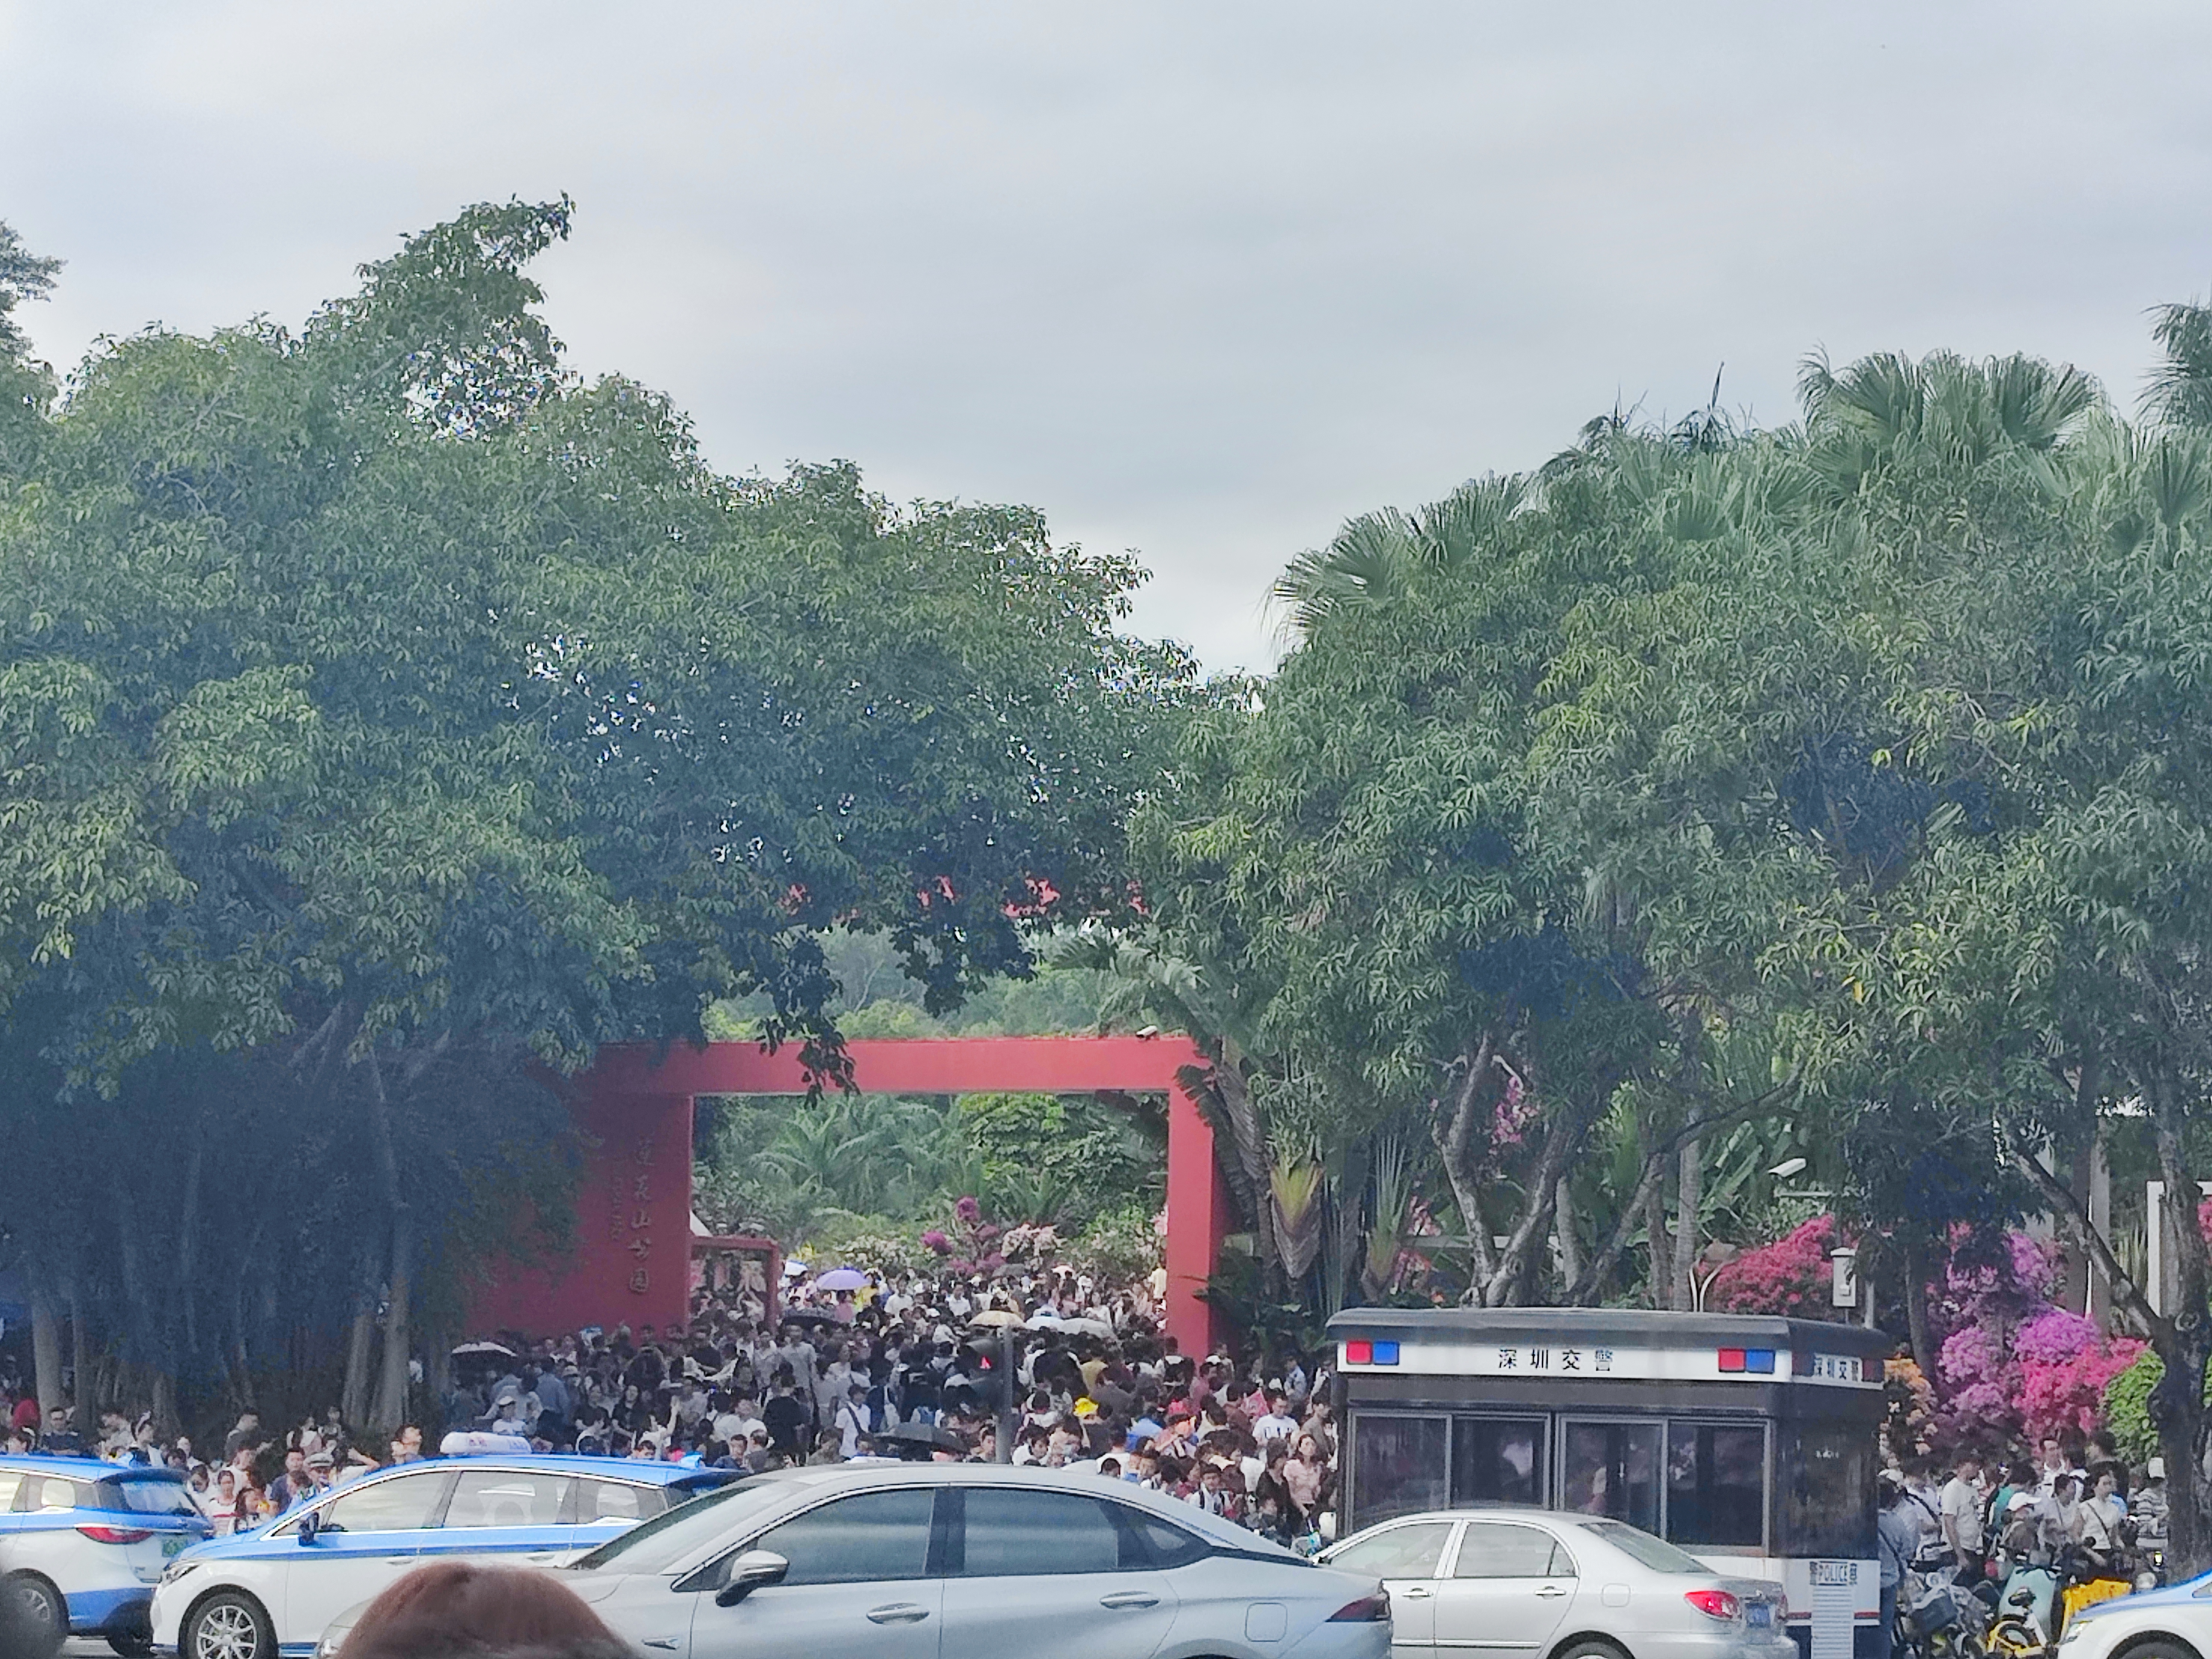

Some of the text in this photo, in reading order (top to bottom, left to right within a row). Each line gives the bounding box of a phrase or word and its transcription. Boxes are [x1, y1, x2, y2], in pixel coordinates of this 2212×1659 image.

[1498, 1349, 1613, 1371] 深圳交警
[1819, 1564, 1848, 1581] POLICE
